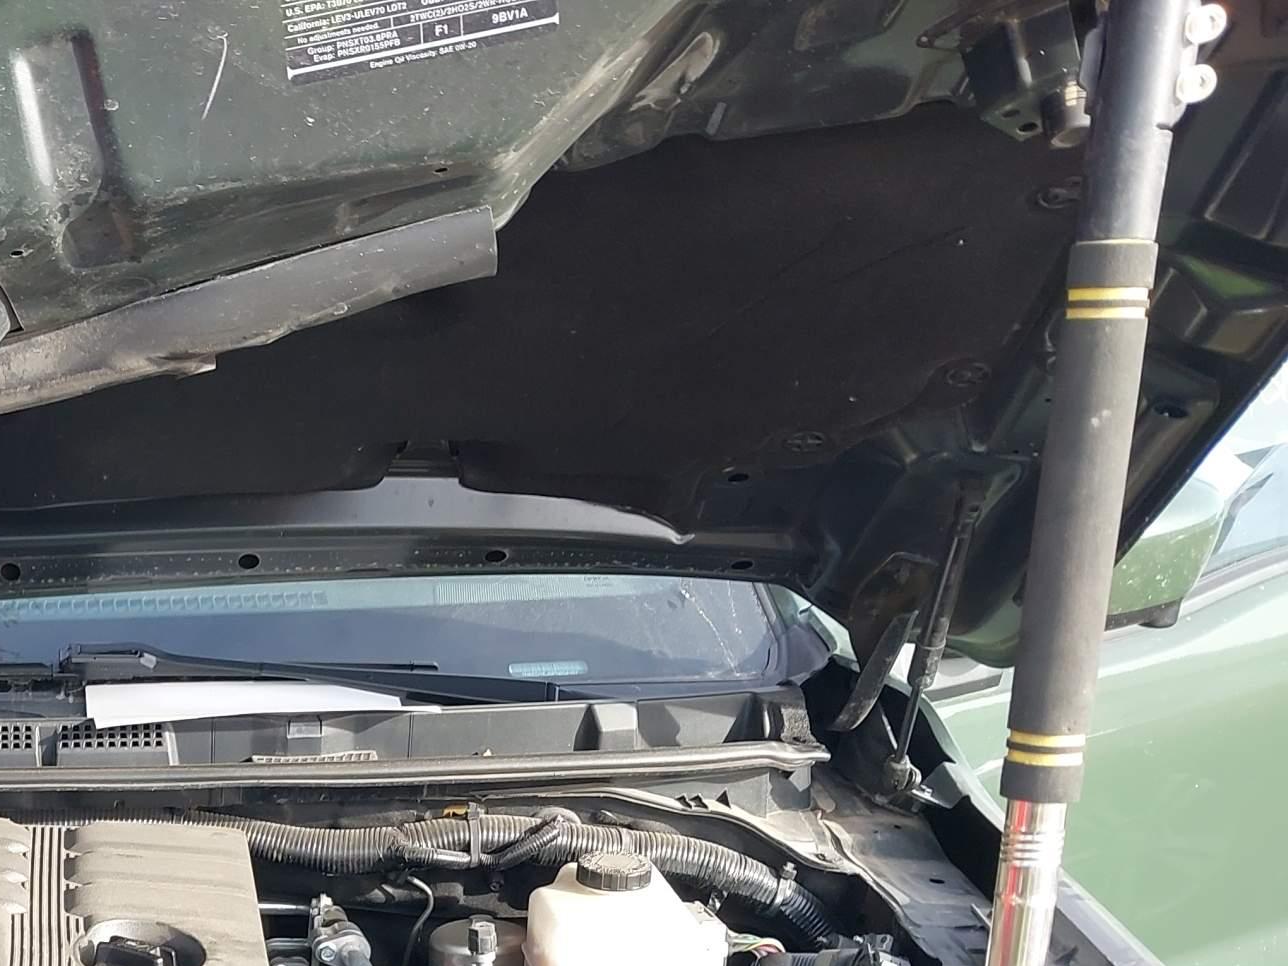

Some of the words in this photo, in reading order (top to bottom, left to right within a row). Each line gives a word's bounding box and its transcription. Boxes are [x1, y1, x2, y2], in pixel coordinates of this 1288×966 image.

[287, 18, 330, 33] California:
[330, 7, 386, 24] LEV3-ULEV70
[491, 7, 529, 24] 9BV1A
[434, 24, 449, 37] F1
[307, 45, 335, 55] Group:
[313, 52, 336, 63] Evap:
